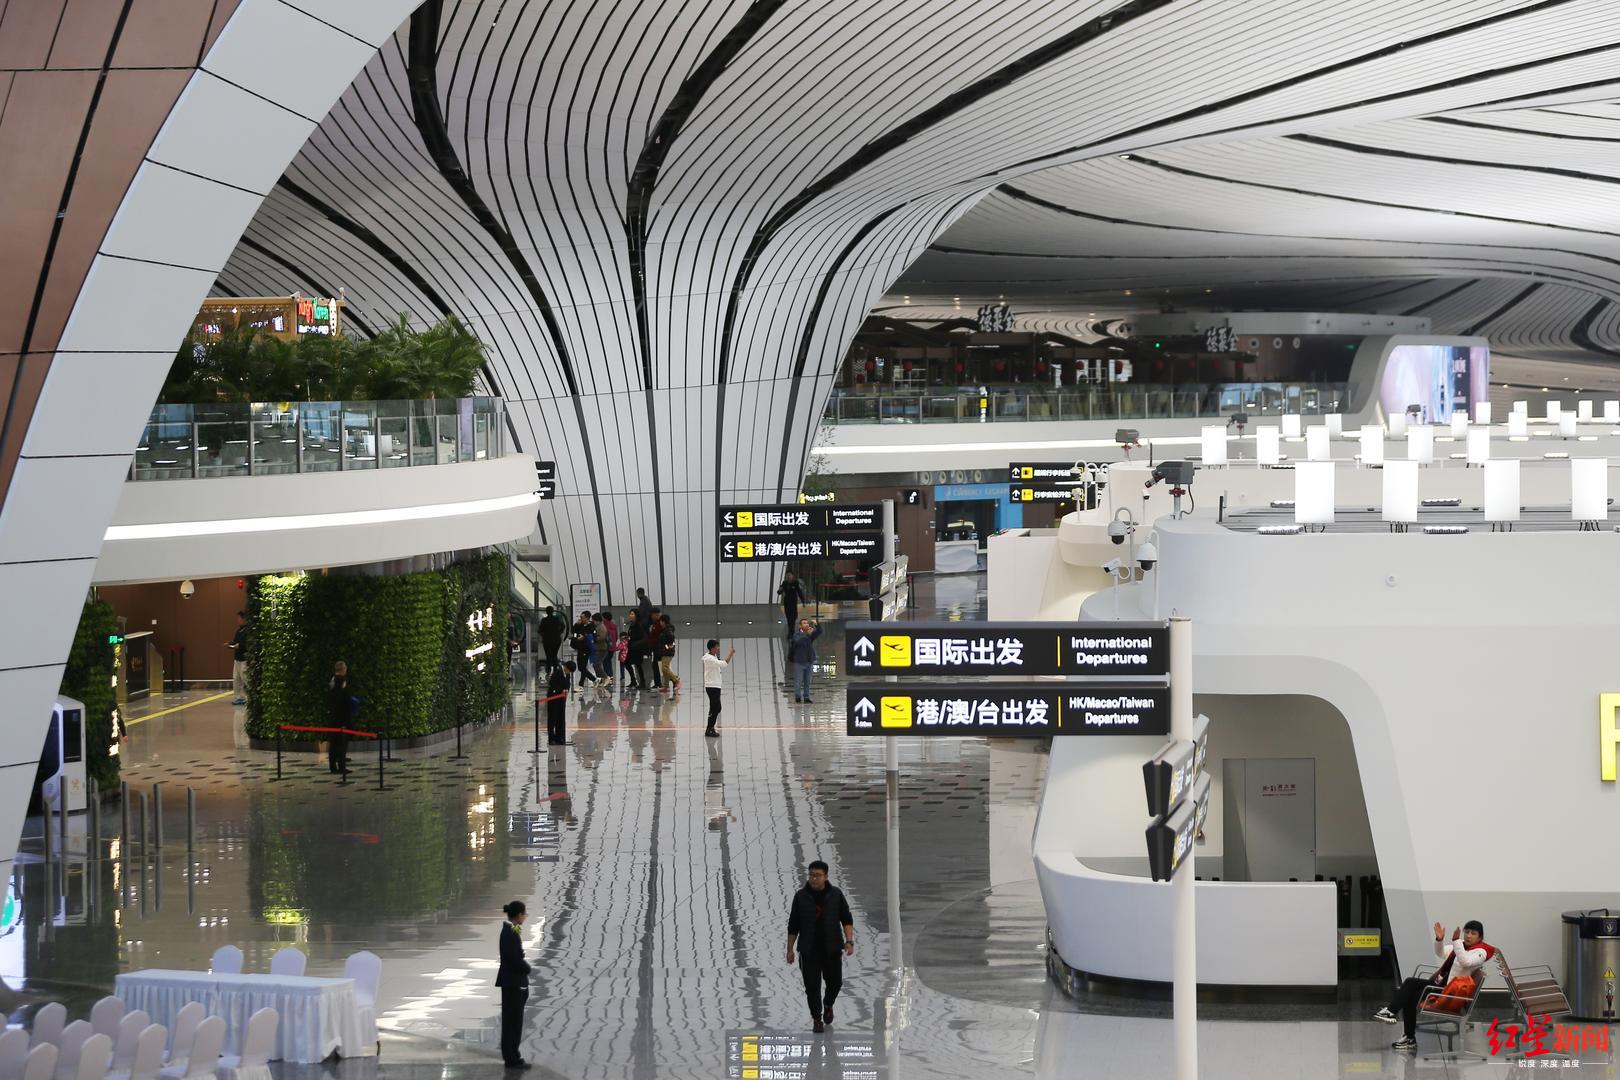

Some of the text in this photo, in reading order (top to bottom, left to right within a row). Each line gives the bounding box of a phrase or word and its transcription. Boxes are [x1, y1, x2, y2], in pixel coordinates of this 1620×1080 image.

[753, 510, 809, 527] 国际出发
[832, 509, 874, 517] International
[835, 517, 873, 526] Departures
[754, 541, 822, 556] 港/澳/台出发
[831, 539, 875, 547] HK/Macao/Taiwan
[839, 547, 868, 555] Departures
[1071, 636, 1152, 649] International
[914, 637, 1024, 666] 国际出发
[1076, 652, 1148, 667] Departures
[1069, 696, 1155, 710] HK/Macao/Taiwan
[916, 698, 1049, 726] 港/澳/台出发
[1085, 712, 1140, 727] Departures
